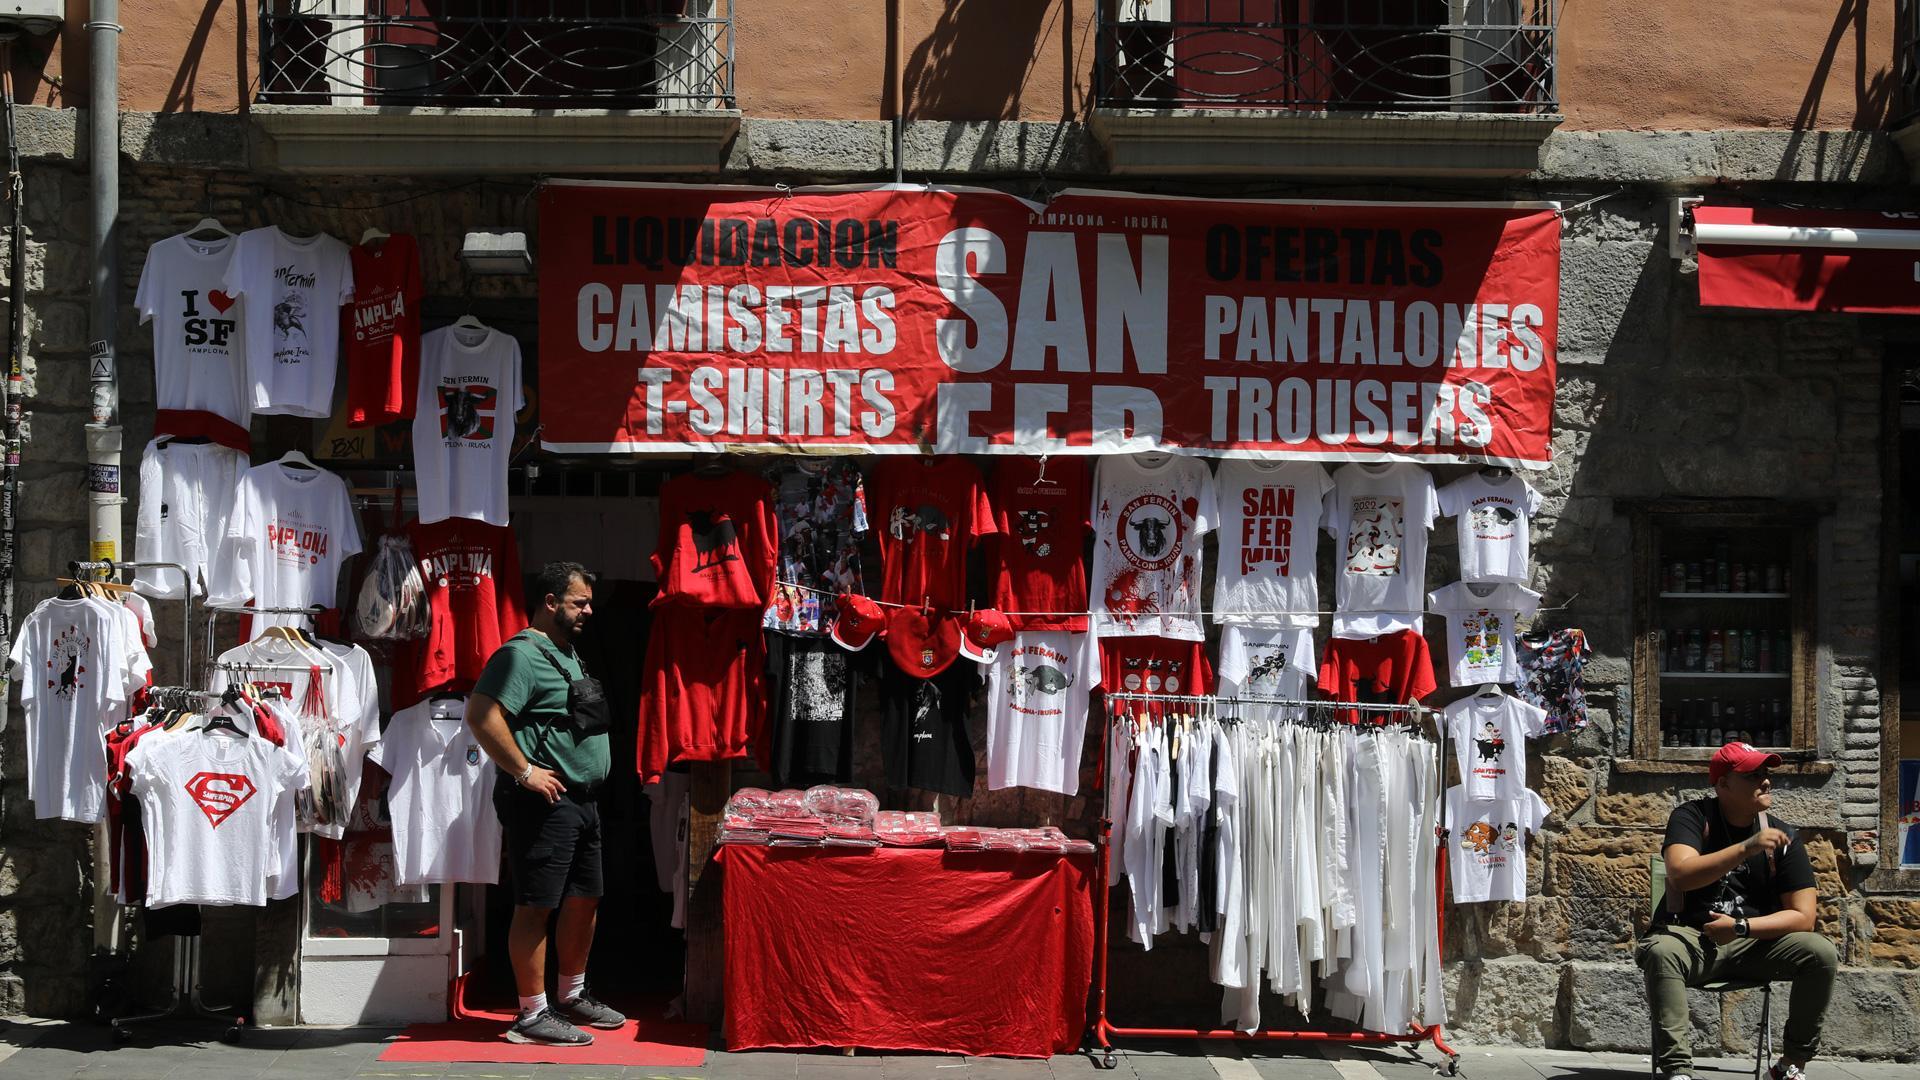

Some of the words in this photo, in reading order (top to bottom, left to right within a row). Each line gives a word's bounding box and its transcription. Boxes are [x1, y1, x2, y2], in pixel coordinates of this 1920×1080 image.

[1029, 213, 1104, 227] PAMPLONA
[1125, 215, 1168, 229] IRUÑA
[593, 216, 898, 270] LIQUIDACION
[1205, 224, 1444, 288] OFERTAS
[181, 289, 200, 317] I
[935, 227, 1169, 374] SAN
[184, 318, 236, 346] SF
[577, 282, 897, 354] CAMISETAS
[1204, 295, 1545, 372] PANTALONES
[458, 375, 489, 384] FERMIN
[638, 366, 896, 438] T-SHIRTS
[1204, 376, 1494, 447] TROUSERS
[1123, 500, 1141, 518] SAN
[1143, 496, 1179, 516] FERMIN
[1243, 488, 1295, 517] SAN
[1242, 518, 1292, 547] FER
[1028, 646, 1069, 664] FERMIN
